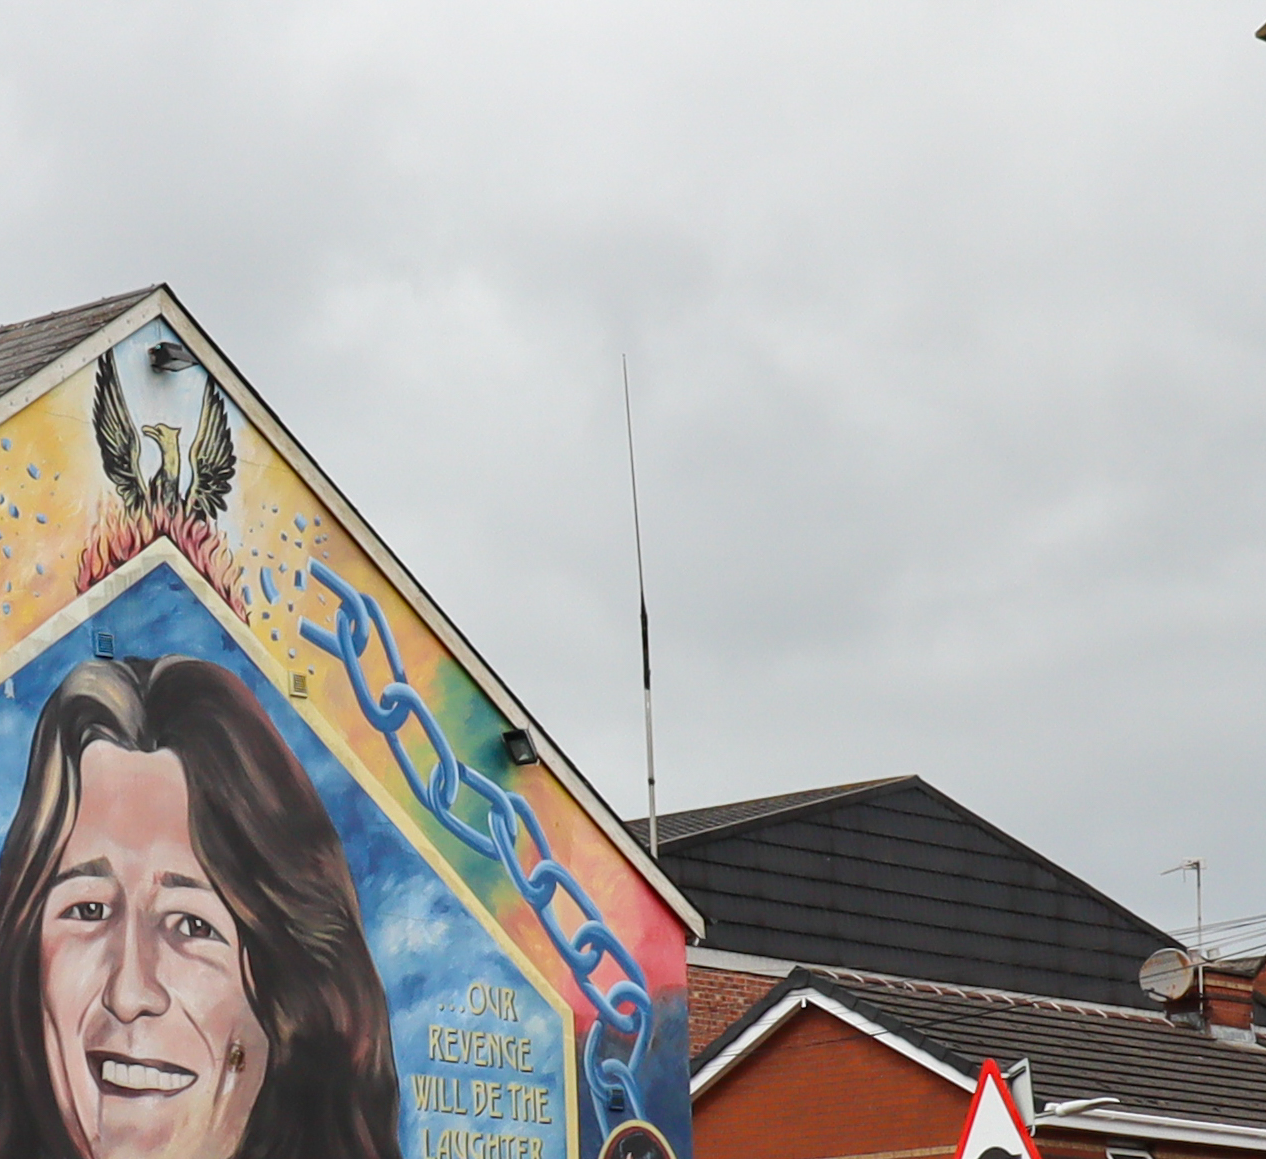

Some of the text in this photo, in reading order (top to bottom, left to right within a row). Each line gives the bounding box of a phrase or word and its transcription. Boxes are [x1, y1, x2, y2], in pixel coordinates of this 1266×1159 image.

[429, 1024, 533, 1073] REVENGE
[411, 1074, 552, 1124] WILL BE THE
